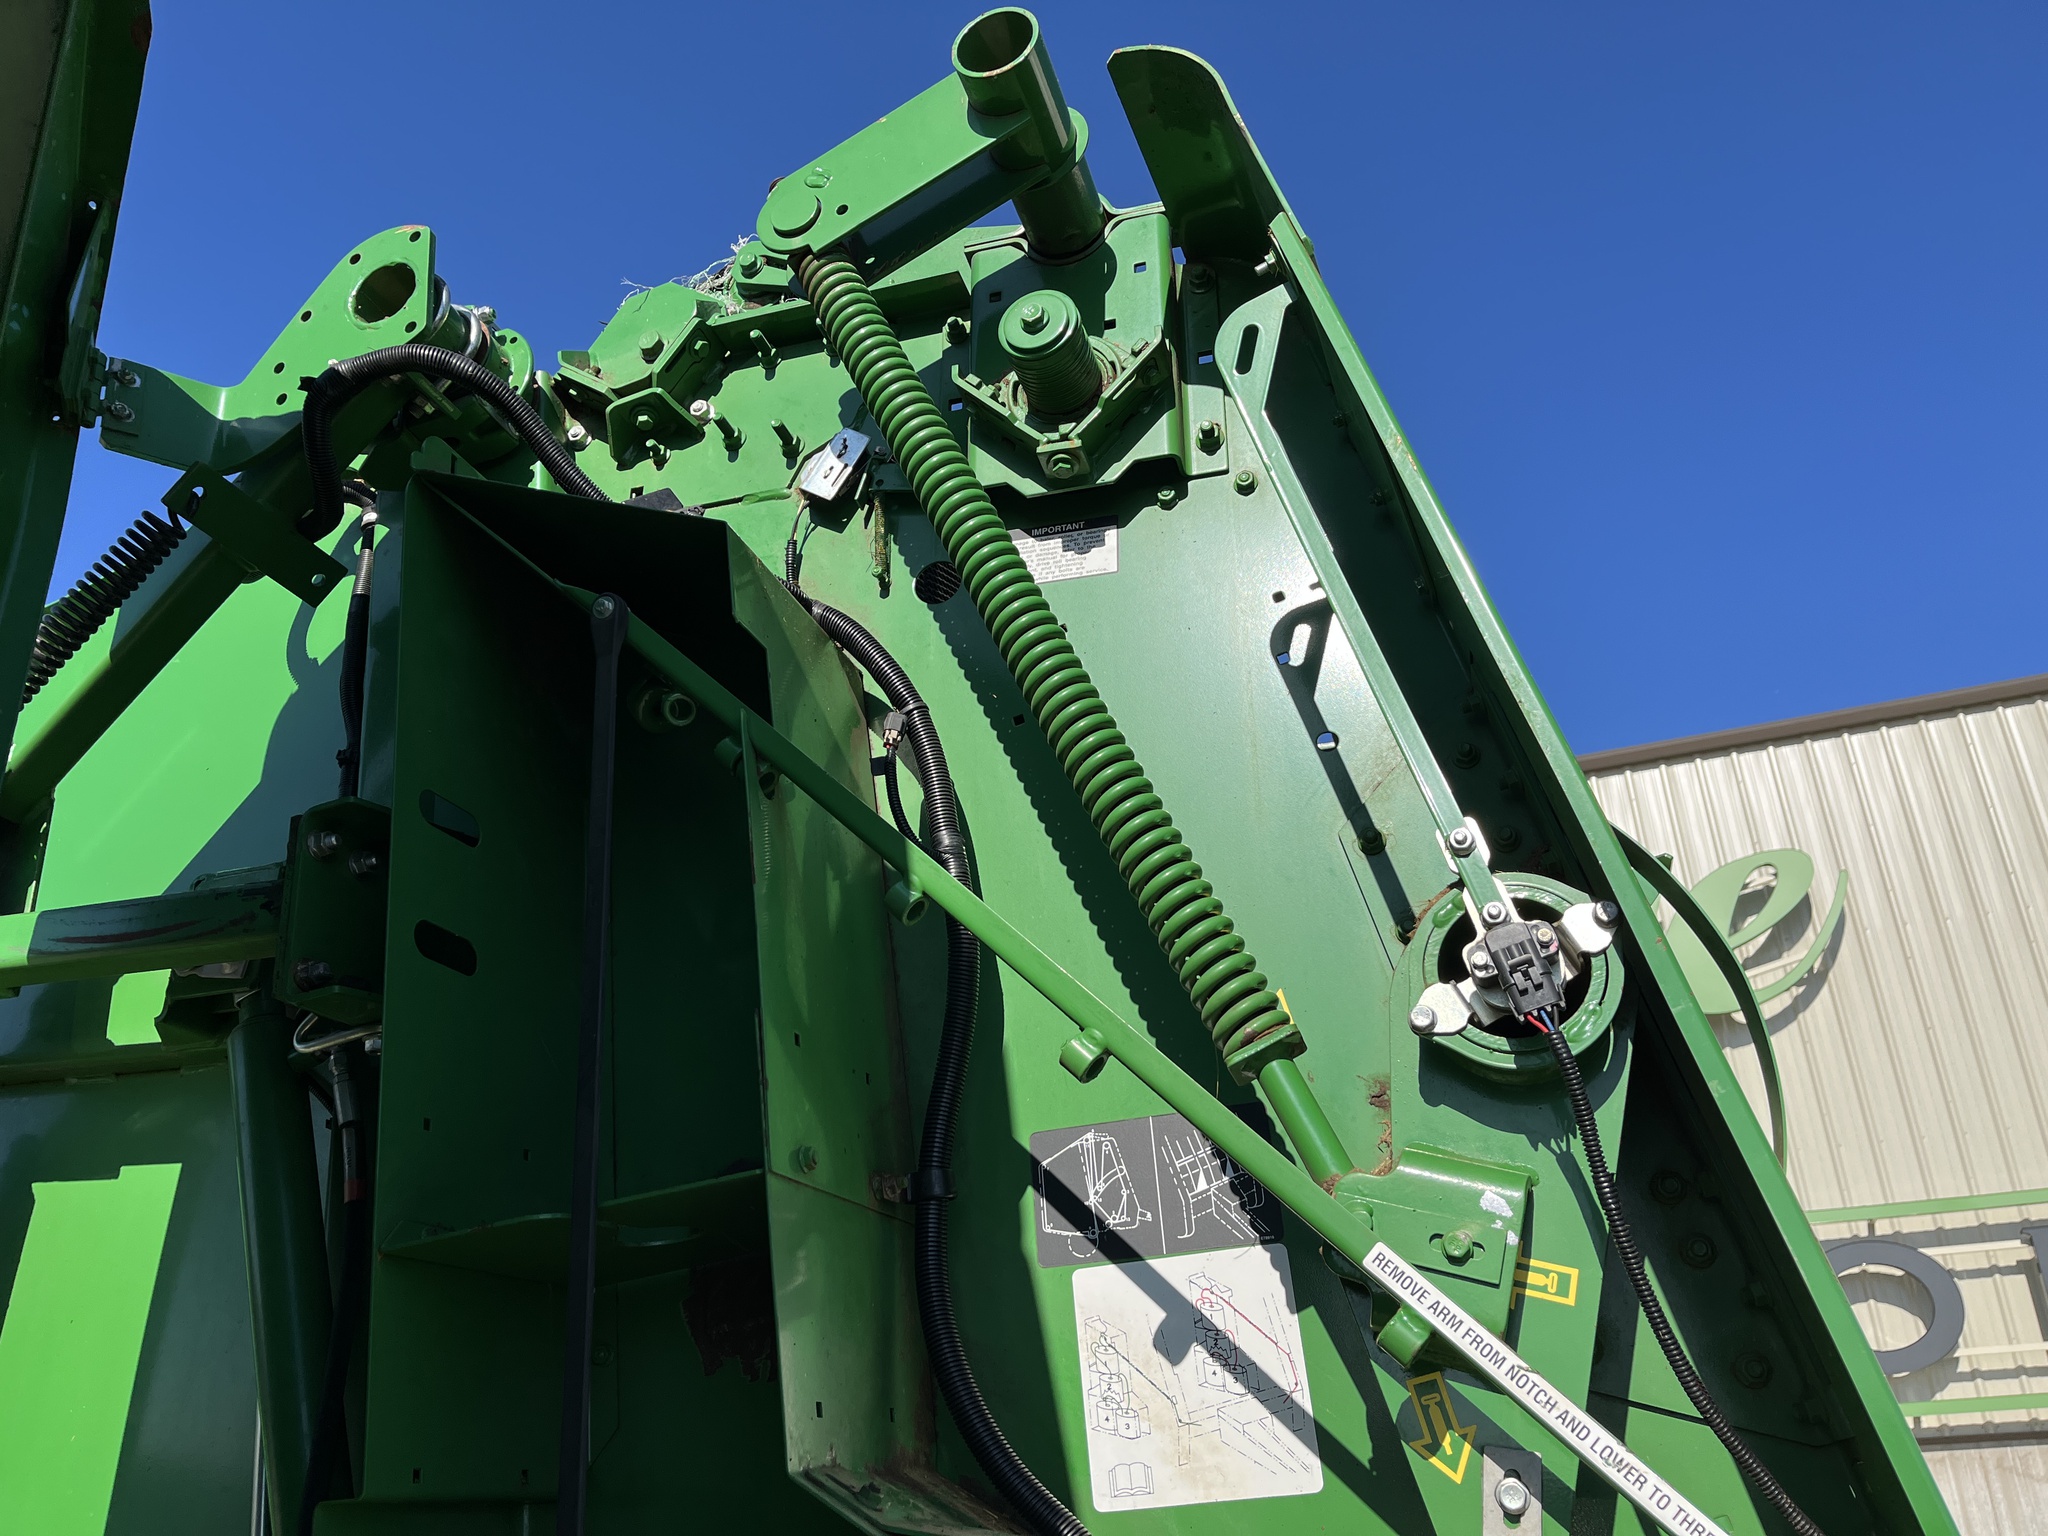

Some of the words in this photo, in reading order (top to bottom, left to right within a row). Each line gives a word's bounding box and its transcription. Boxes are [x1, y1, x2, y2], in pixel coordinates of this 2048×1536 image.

[1031, 521, 1085, 537] IMPORTANT
[1083, 538, 1105, 546] prevent
[1065, 556, 1087, 564] bearing
[1054, 561, 1083, 569] tightening
[1051, 571, 1083, 580] performing
[1213, 1338, 1218, 1346] 2
[1372, 1252, 1431, 1305] REMOVE
[1427, 1300, 1464, 1333] ARM
[1461, 1327, 1507, 1370] FROM
[1505, 1364, 1558, 1414] NOTCH
[1555, 1409, 1591, 1441] AND
[1590, 1436, 1649, 1492] LOWER
[1648, 1484, 1671, 1511] TO
